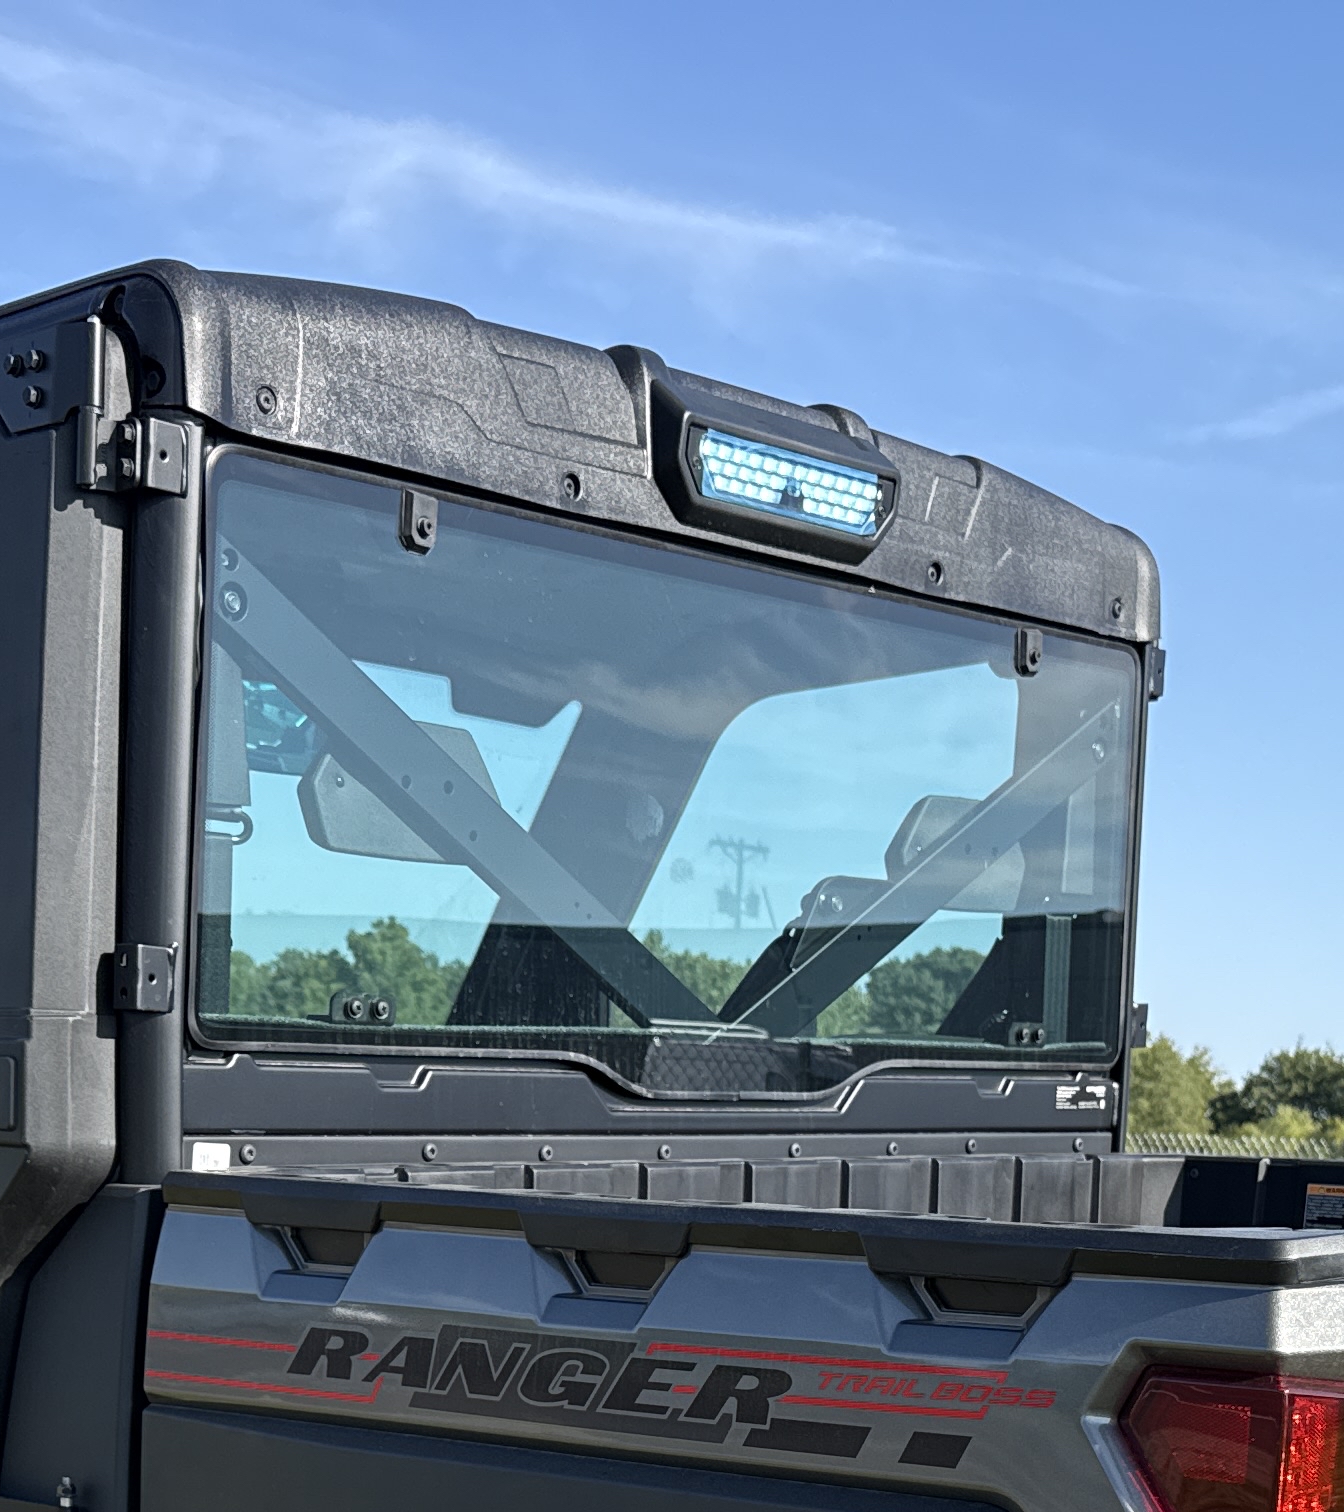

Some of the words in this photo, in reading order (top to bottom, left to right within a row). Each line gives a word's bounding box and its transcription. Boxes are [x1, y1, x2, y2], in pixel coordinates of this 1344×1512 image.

[287, 1327, 792, 1425] RANGER
[818, 1371, 924, 1399] TRAIL
[930, 1381, 1056, 1408] BOSS
